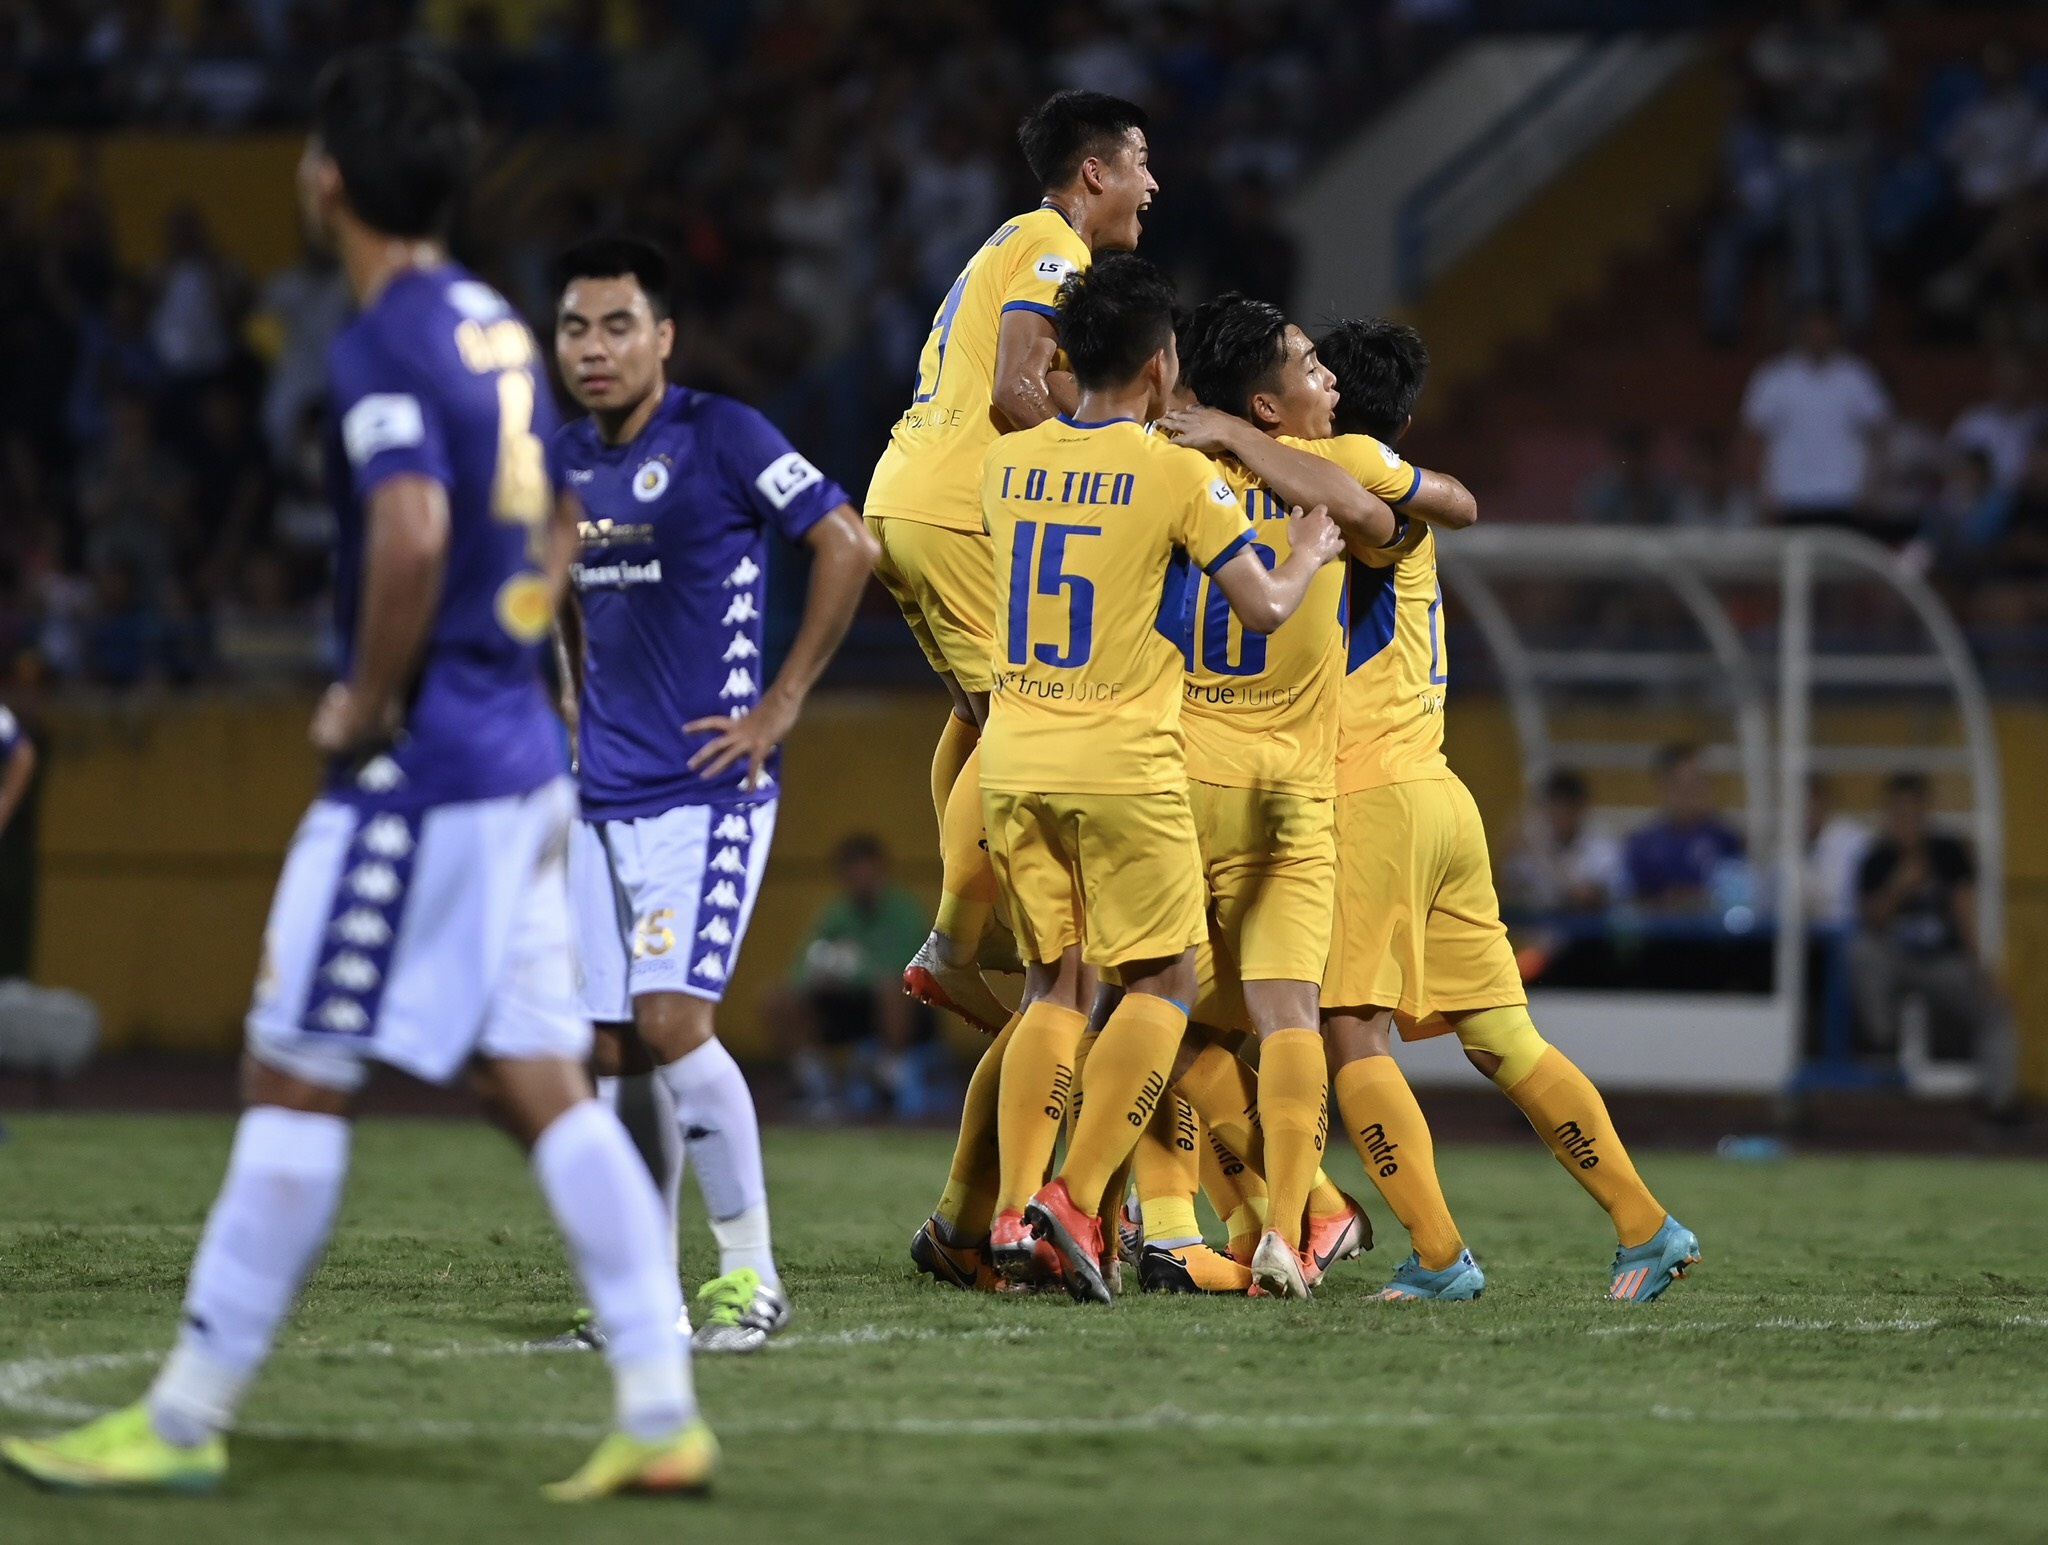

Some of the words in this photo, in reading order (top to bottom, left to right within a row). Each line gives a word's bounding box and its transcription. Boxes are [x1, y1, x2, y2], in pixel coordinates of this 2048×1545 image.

[1007, 520, 1103, 669] 15
[1126, 1070, 1164, 1127] mitre
[1359, 1122, 1399, 1178] mitre
[1553, 1119, 1600, 1170] mitre
